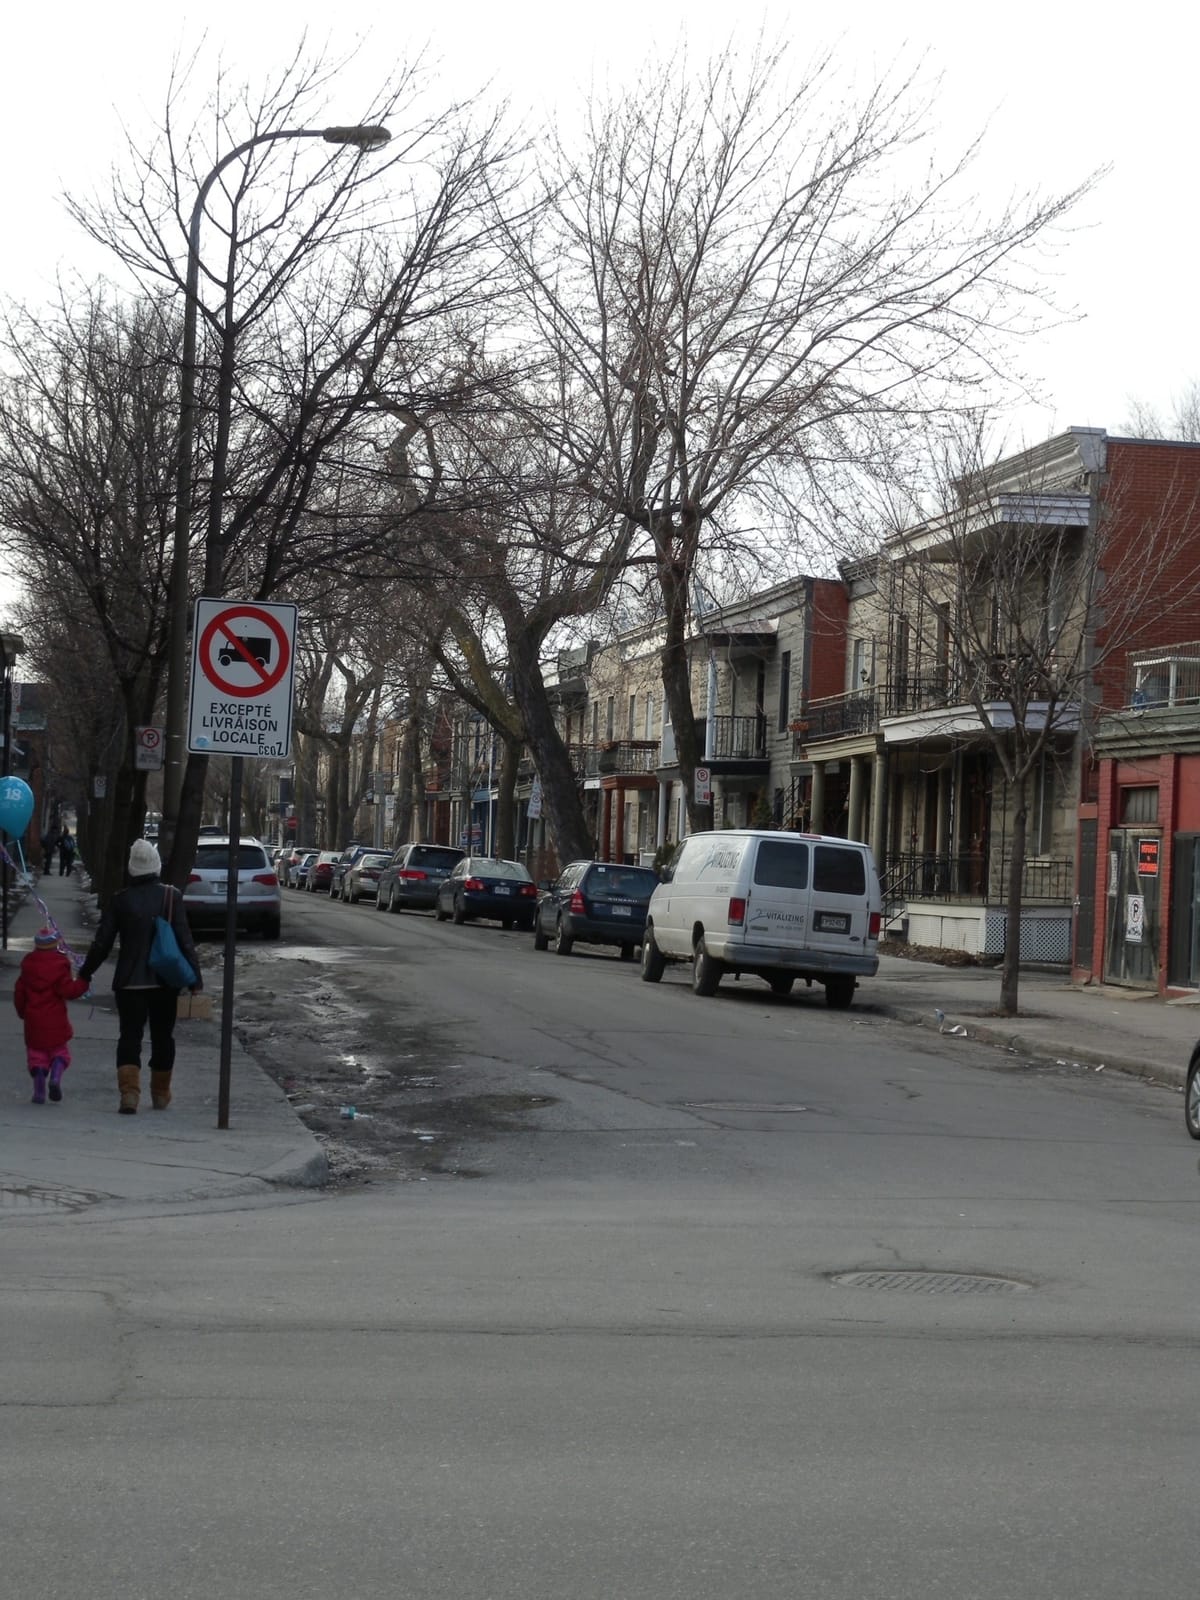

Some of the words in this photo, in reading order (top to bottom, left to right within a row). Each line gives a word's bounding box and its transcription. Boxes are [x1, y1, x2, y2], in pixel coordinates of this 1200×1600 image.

[210, 702, 271, 718] EXCEPTÉ
[202, 715, 278, 732] LIVRAISON
[213, 730, 265, 745] LOCALE
